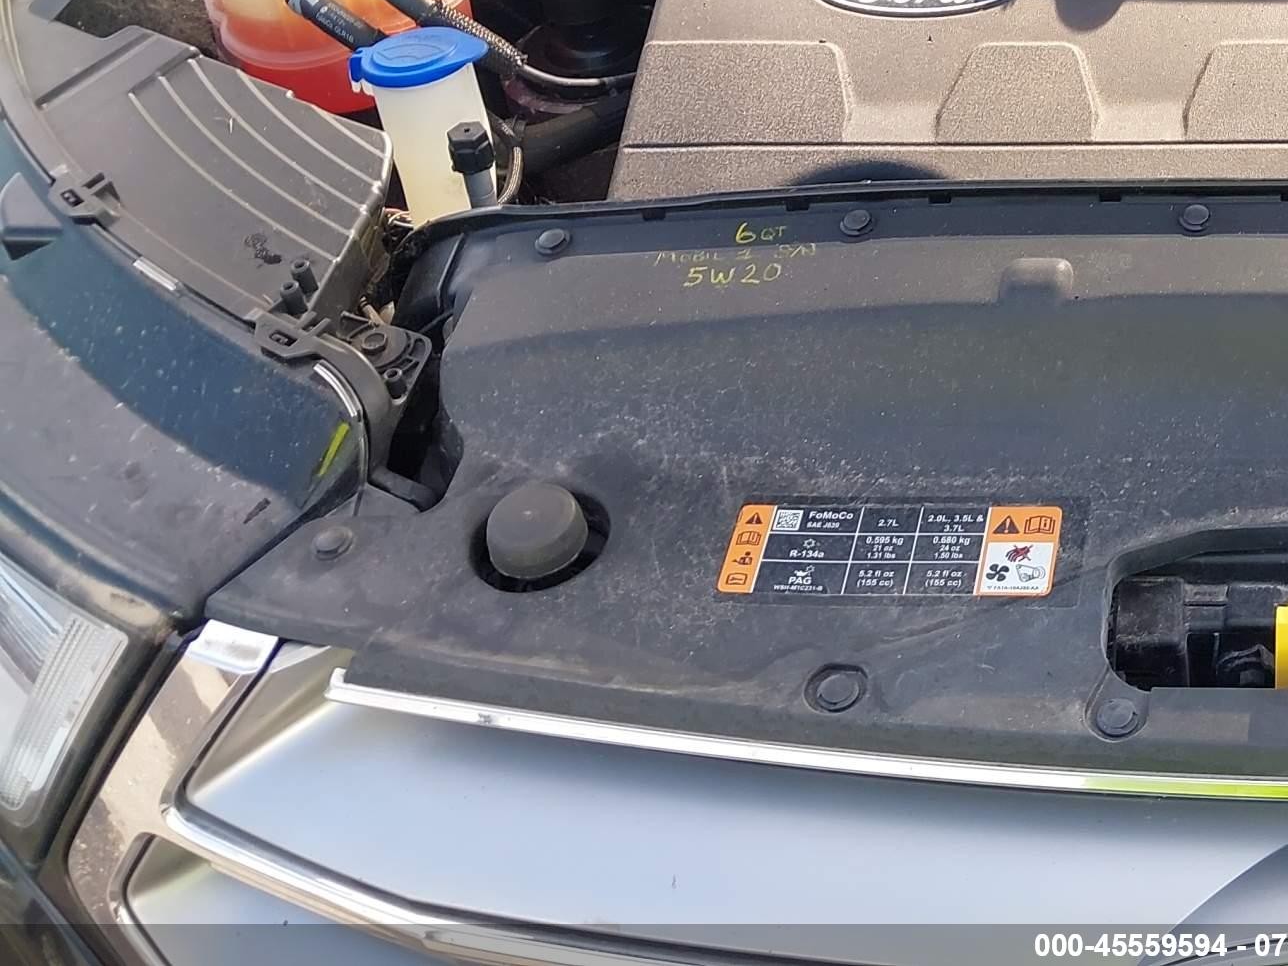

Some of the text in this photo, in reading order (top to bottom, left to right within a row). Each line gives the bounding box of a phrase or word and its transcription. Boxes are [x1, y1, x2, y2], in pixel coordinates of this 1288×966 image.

[808, 511, 854, 520] FoMoCo
[953, 515, 974, 523] 3.5L
[976, 515, 984, 523] &
[877, 519, 899, 527] 2.7L
[866, 536, 904, 546] 0.595 kg
[932, 536, 971, 546] 0.680 kg
[789, 550, 825, 558] R-134a
[858, 570, 872, 578] 5.2
[926, 570, 940, 578] 5.2
[788, 576, 812, 585] PAG
[856, 579, 894, 588] (155 cc)
[925, 579, 962, 588] (155 cc)
